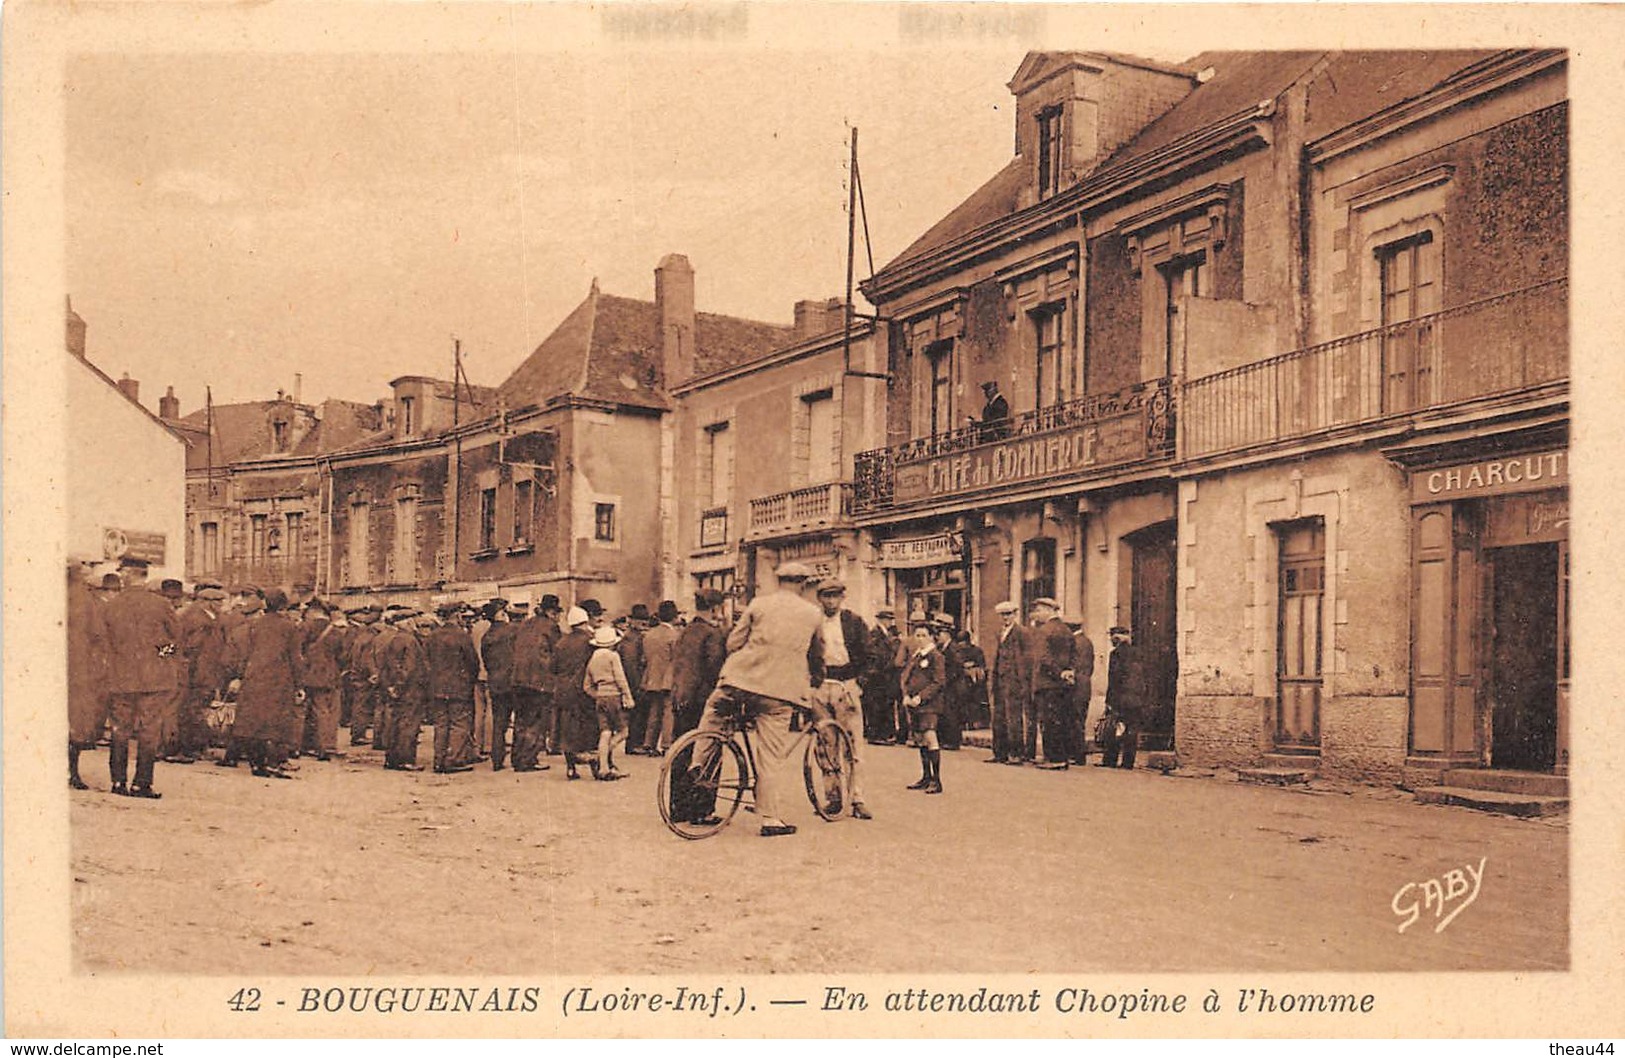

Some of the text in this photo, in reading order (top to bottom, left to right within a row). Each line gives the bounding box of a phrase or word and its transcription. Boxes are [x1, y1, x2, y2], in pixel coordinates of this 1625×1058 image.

[972, 458, 990, 485] du
[992, 428, 1098, 480] COMMERCE
[1427, 453, 1563, 493] CHARCUT
